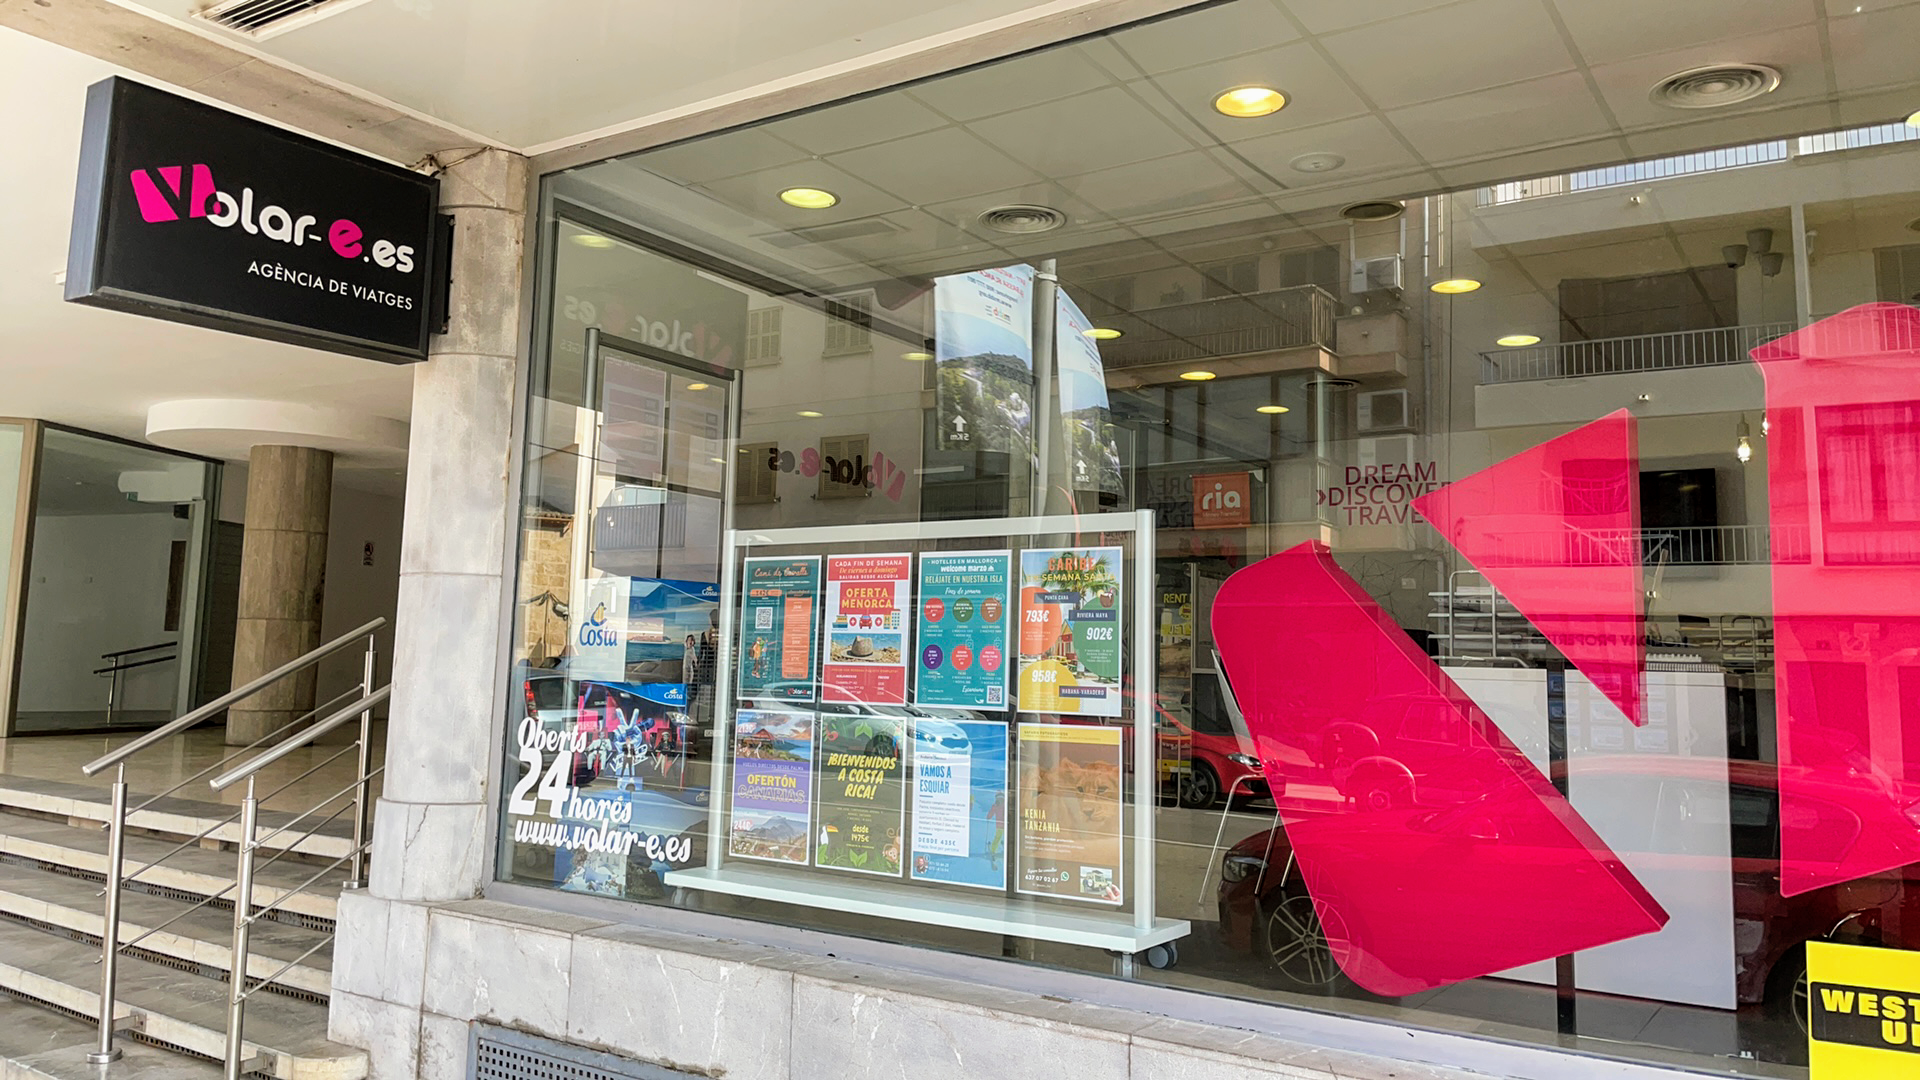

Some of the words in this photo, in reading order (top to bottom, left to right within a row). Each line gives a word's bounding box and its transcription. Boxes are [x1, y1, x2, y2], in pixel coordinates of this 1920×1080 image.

[247, 260, 324, 290] AGÈNCIA
[328, 278, 348, 296] DE
[352, 284, 413, 311] VIATGES
[1345, 461, 1437, 486] DREAM
[1202, 482, 1241, 510] ria
[1328, 481, 1453, 506] DISCOVE
[1342, 504, 1426, 526] TRAVE
[1048, 557, 1096, 571] CARIBE
[953, 575, 961, 583] EN
[962, 575, 988, 583] NUESTRA
[989, 575, 1003, 583] ISLA
[1041, 573, 1081, 581] SEMANA
[846, 587, 889, 598] OFERTA
[1163, 593, 1188, 603] RENT
[841, 599, 893, 609] MENORCA
[1025, 609, 1050, 623] 793€
[580, 622, 618, 647] Costa
[1086, 627, 1114, 640] 902€
[1031, 669, 1057, 682] 958€
[827, 752, 897, 770] ¡BIENVENIDOS
[837, 767, 846, 781] A
[848, 768, 884, 784] COSTA
[920, 764, 945, 778] VAMOS
[946, 766, 952, 778] A
[508, 750, 573, 818] 24
[568, 786, 632, 823] hores
[747, 773, 797, 788] OFERTÓN
[919, 779, 950, 794] ESQUIAR
[737, 784, 806, 804] CANARIAS
[844, 783, 877, 800] RICA!
[1024, 808, 1046, 820] KENIA
[852, 824, 869, 833] desde
[1024, 820, 1060, 833] TANZANIA
[514, 818, 693, 863] www.volar-e.es
